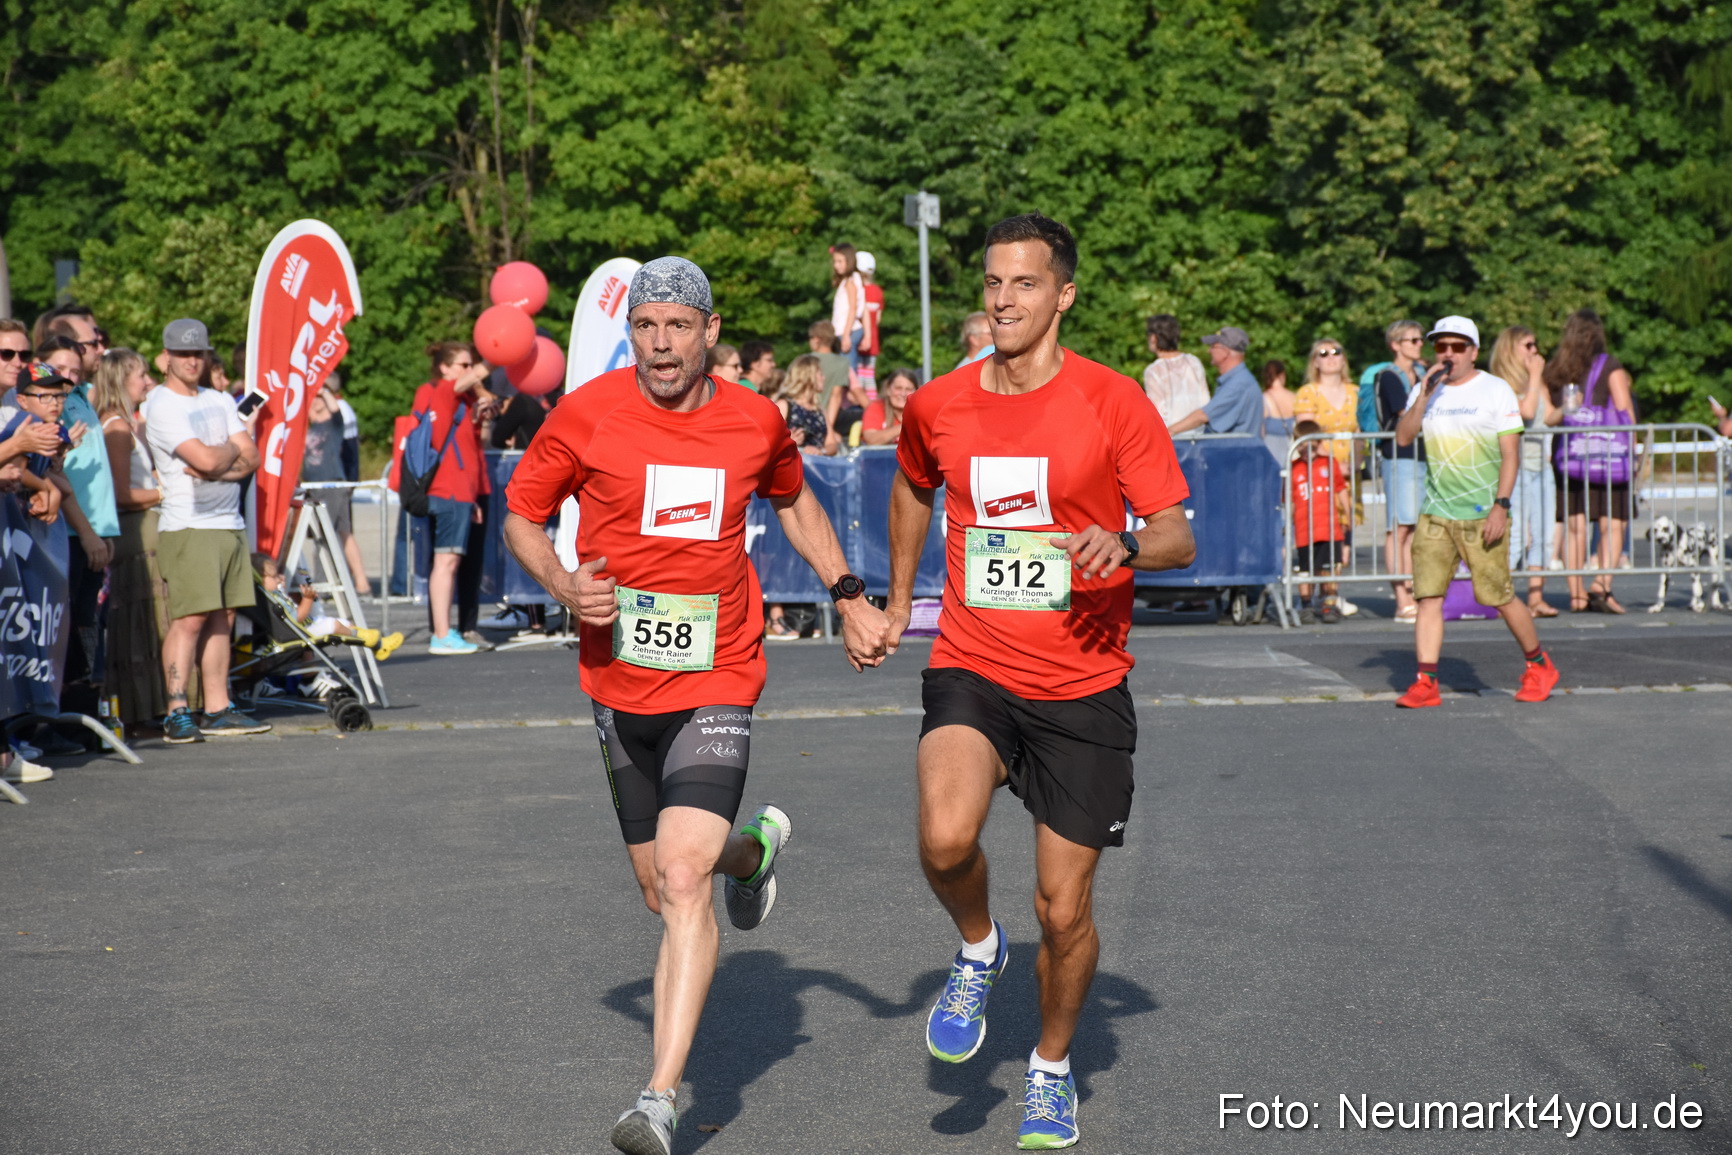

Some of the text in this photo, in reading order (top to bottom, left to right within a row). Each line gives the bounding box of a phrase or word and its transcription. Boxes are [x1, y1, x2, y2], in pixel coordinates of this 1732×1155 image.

[280, 252, 302, 294] AVIA
[597, 275, 620, 312] AVIA
[998, 498, 1023, 512] DEHN
[669, 507, 697, 520] DEHN
[980, 544, 1021, 554] firmenlauf
[1044, 553, 1065, 561] 2019
[986, 558, 1046, 588] 512
[980, 586, 1018, 597] Kürzinger
[629, 603, 670, 616] firmenlauf
[692, 614, 711, 622] 2019
[633, 618, 693, 650] 558
[632, 645, 693, 658] Ziehmer Rainer
[637, 653, 653, 661] DEHN
